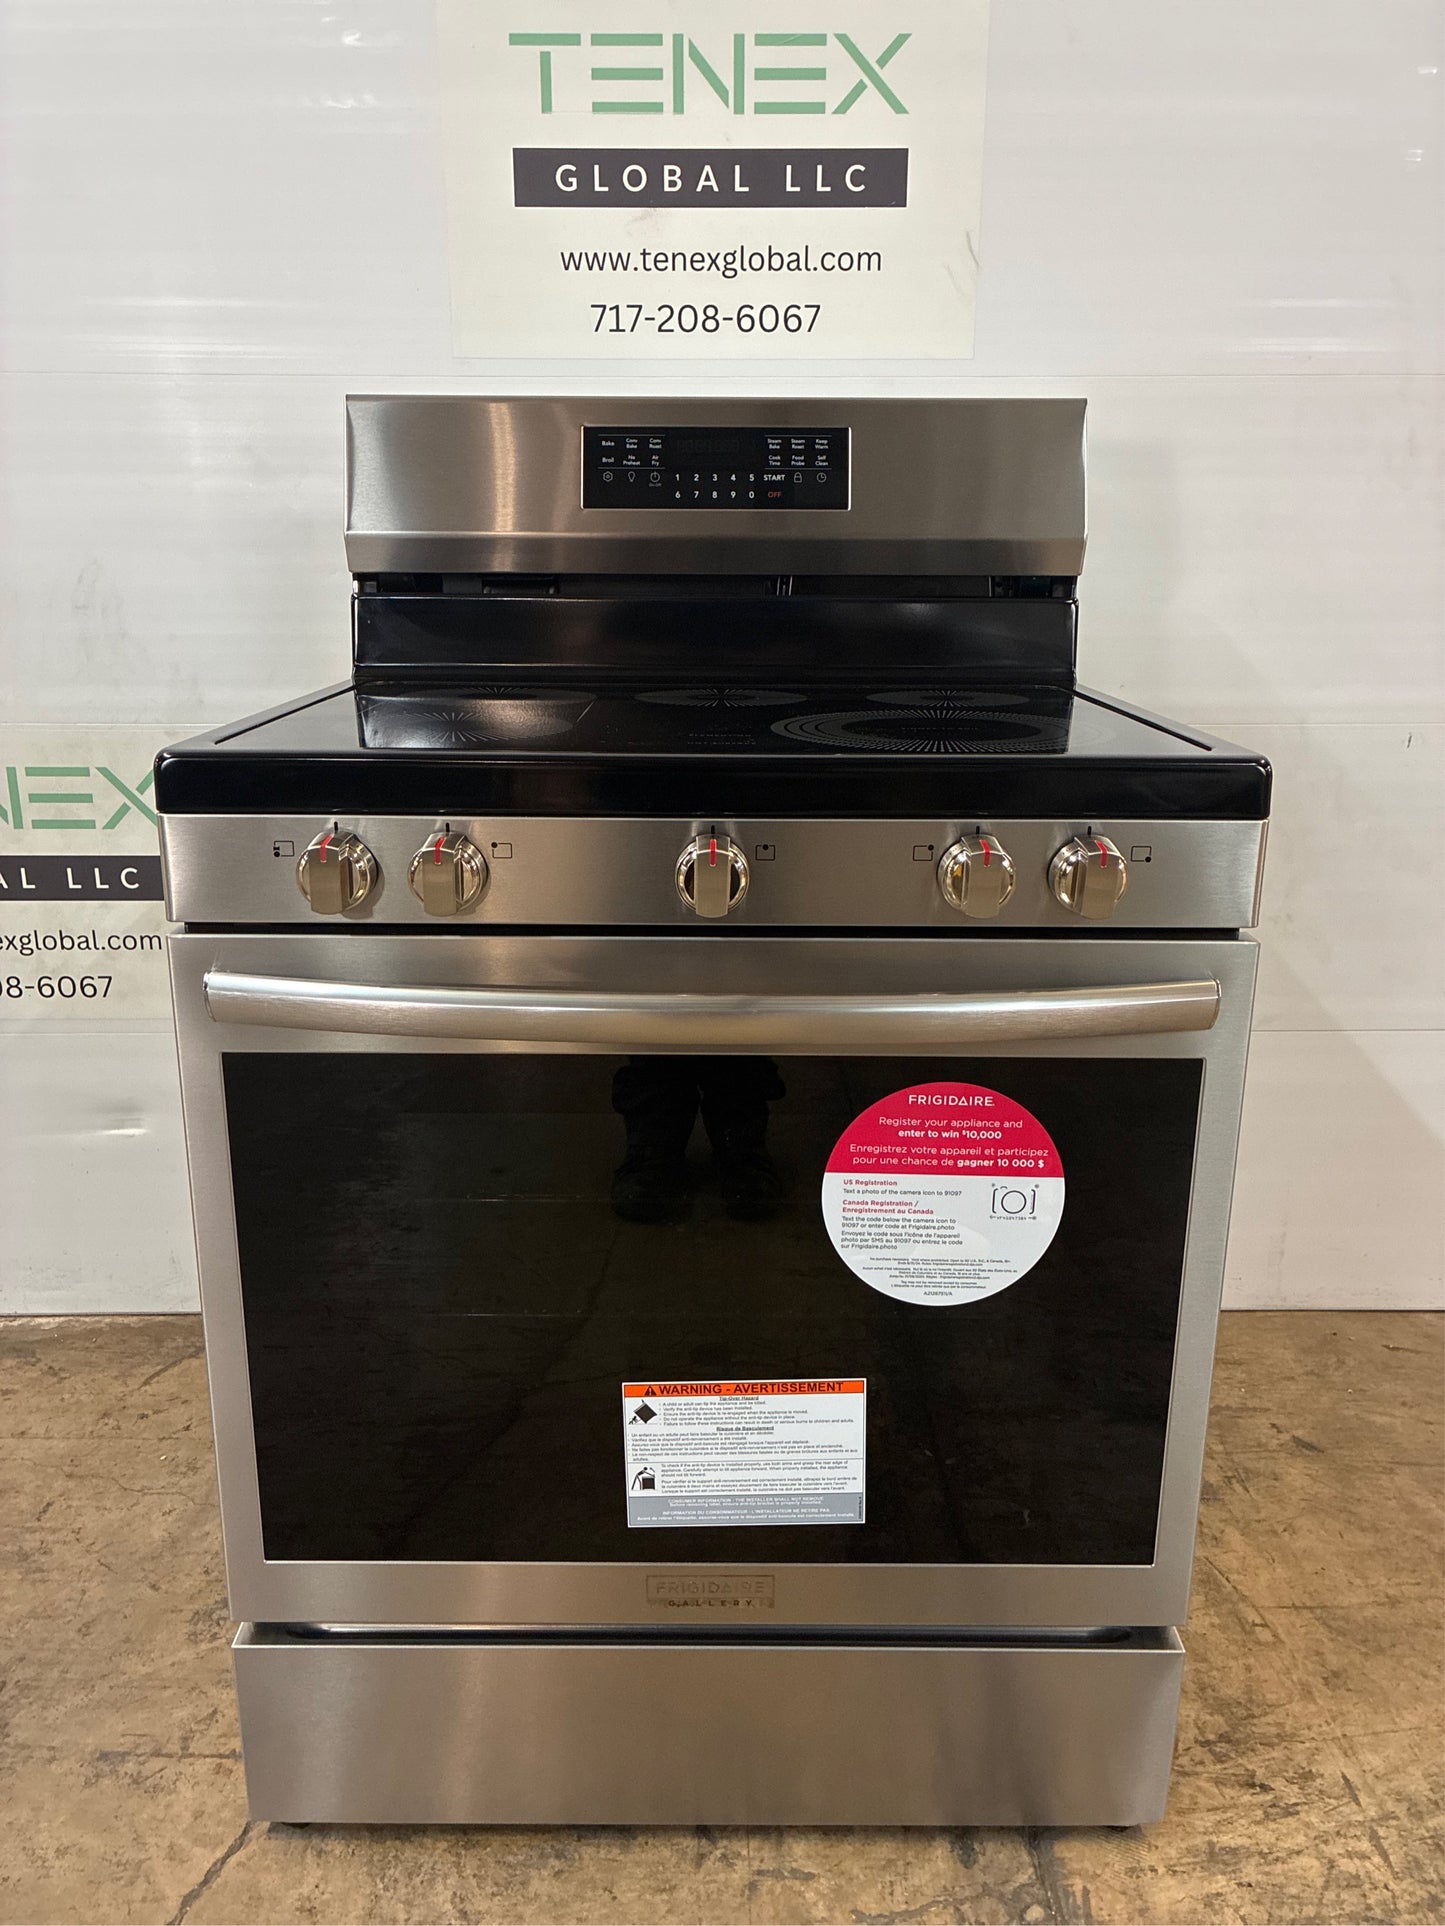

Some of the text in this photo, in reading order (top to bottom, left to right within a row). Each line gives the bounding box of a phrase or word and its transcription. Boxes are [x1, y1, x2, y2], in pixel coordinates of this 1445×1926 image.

[508, 32, 912, 115] TENEX
[555, 164, 867, 193] GLOBAL LLC
[560, 245, 882, 278] www.tenexglobal.com
[590, 304, 822, 333] 717-208-6067
[66, 867, 139, 889] LLC
[0, 930, 162, 956] xglobal.com
[0, 975, 113, 999] 8-6067
[908, 1094, 995, 1107] FRIGIDAIRE
[879, 1117, 1023, 1128] Register your appliance and
[898, 1130, 925, 1138] enter
[941, 1130, 959, 1138] win
[962, 1131, 1002, 1140] $10,000
[850, 1144, 907, 1154] Enregistrez
[911, 1146, 937, 1155] votre
[940, 1146, 981, 1156] appareil
[997, 1147, 1049, 1157] participez
[853, 1157, 877, 1165] pour
[901, 1157, 938, 1166] chance
[941, 1158, 954, 1166] de
[957, 1159, 994, 1167] gagner
[997, 1159, 1008, 1167] 10
[1012, 1159, 1035, 1167] 000
[1038, 1159, 1044, 1168] $
[659, 1384, 722, 1394] WARNING
[733, 1382, 843, 1393] AVERTISSEMENT
